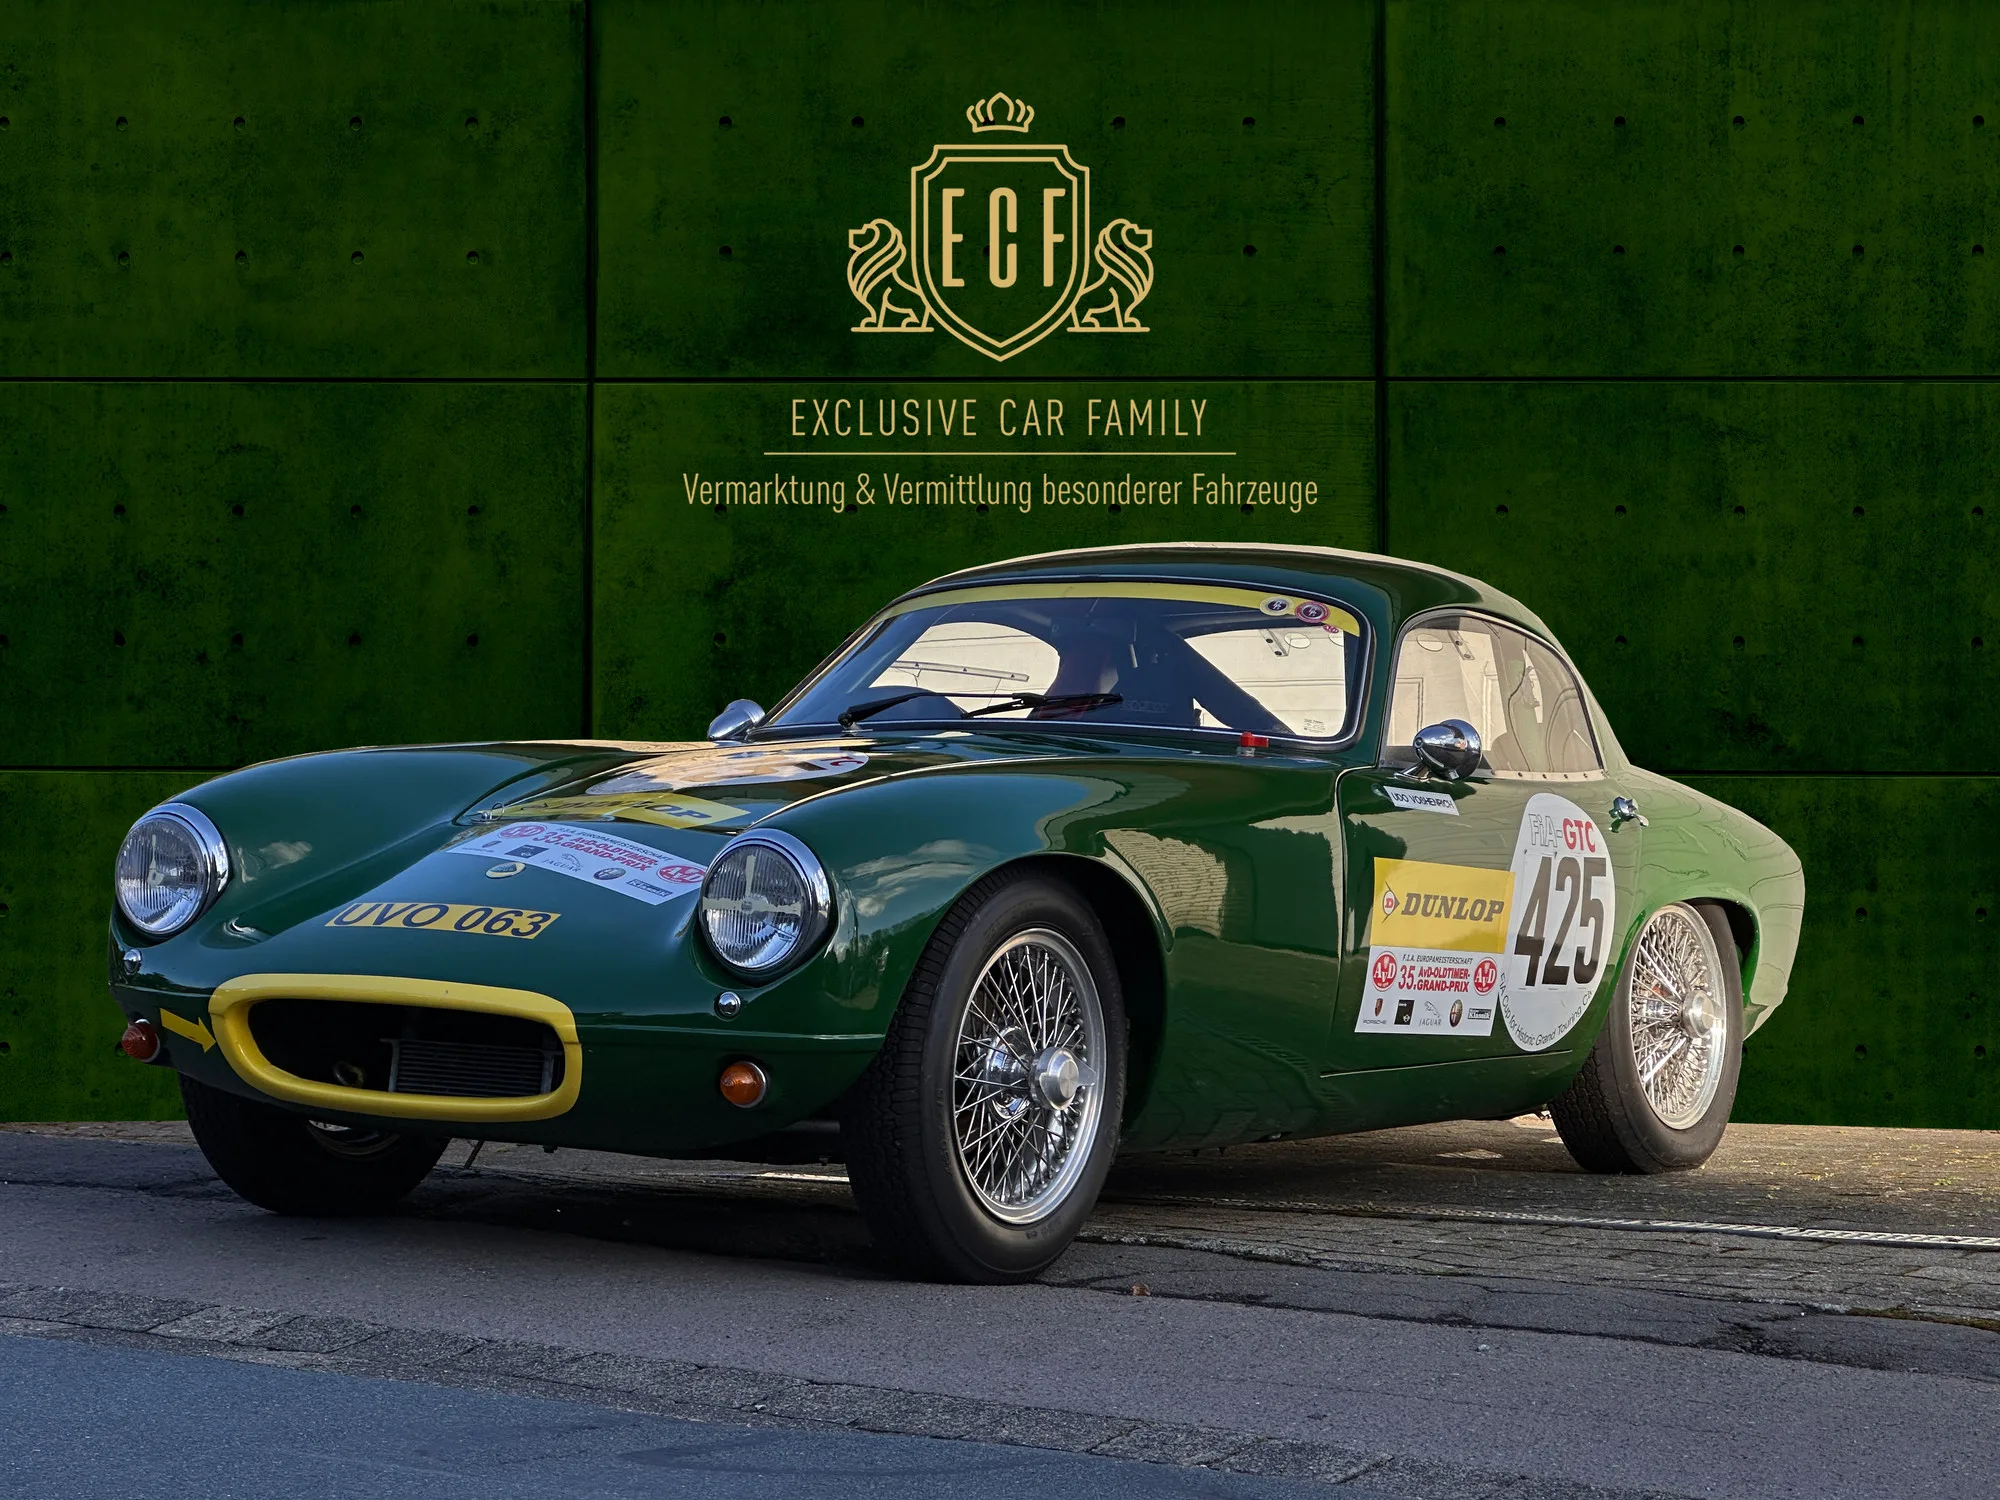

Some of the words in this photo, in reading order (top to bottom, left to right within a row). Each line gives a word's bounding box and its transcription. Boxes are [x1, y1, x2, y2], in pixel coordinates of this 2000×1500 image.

[1391, 792, 1409, 803] UDO
[560, 841, 653, 872] GRAND-PRIX
[334, 903, 449, 927] UVO
[453, 907, 552, 937] 063
[1401, 893, 1504, 922] DUNLOP
[1514, 856, 1606, 987] 425
[1416, 956, 1473, 964] EUROPAMEISTERSCHAFT
[1398, 965, 1416, 990] 35.
[1417, 979, 1469, 992] GRAND-PRIX
[1418, 1018, 1441, 1027] JAGUAR
[1502, 995, 1511, 1019] Cup
[1515, 1025, 1536, 1046] Historic
[1536, 1028, 1557, 1046] Grand
[1558, 1006, 1582, 1035] Touring
